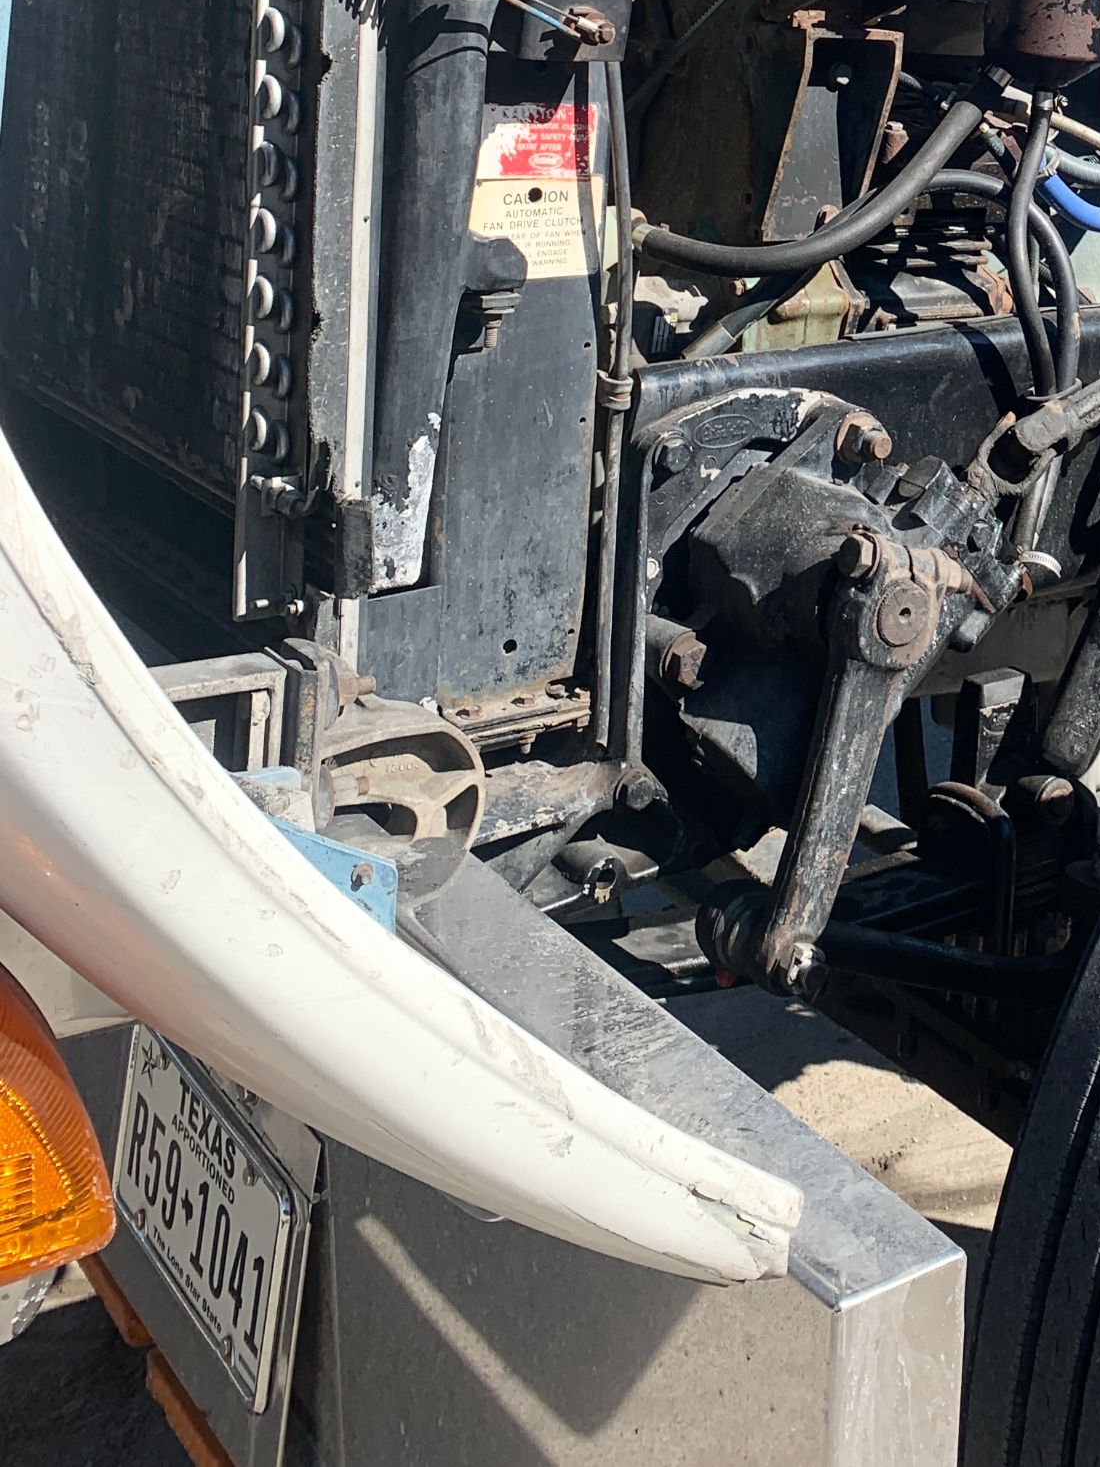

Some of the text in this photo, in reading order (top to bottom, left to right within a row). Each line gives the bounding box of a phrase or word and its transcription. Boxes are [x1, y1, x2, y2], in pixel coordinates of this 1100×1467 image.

[505, 207, 564, 218] AUTOMATIC
[483, 217, 584, 231] FAN DRIVE CLUTCH
[544, 231, 560, 239] FAN
[535, 239, 571, 248] RUNNING
[537, 249, 568, 257] ENGAGE
[531, 258, 568, 267] WARNING
[179, 1079, 236, 1180] TEXAS
[171, 1112, 236, 1205] APPORTIONED
[153, 1227, 223, 1334] The Lone Star State
